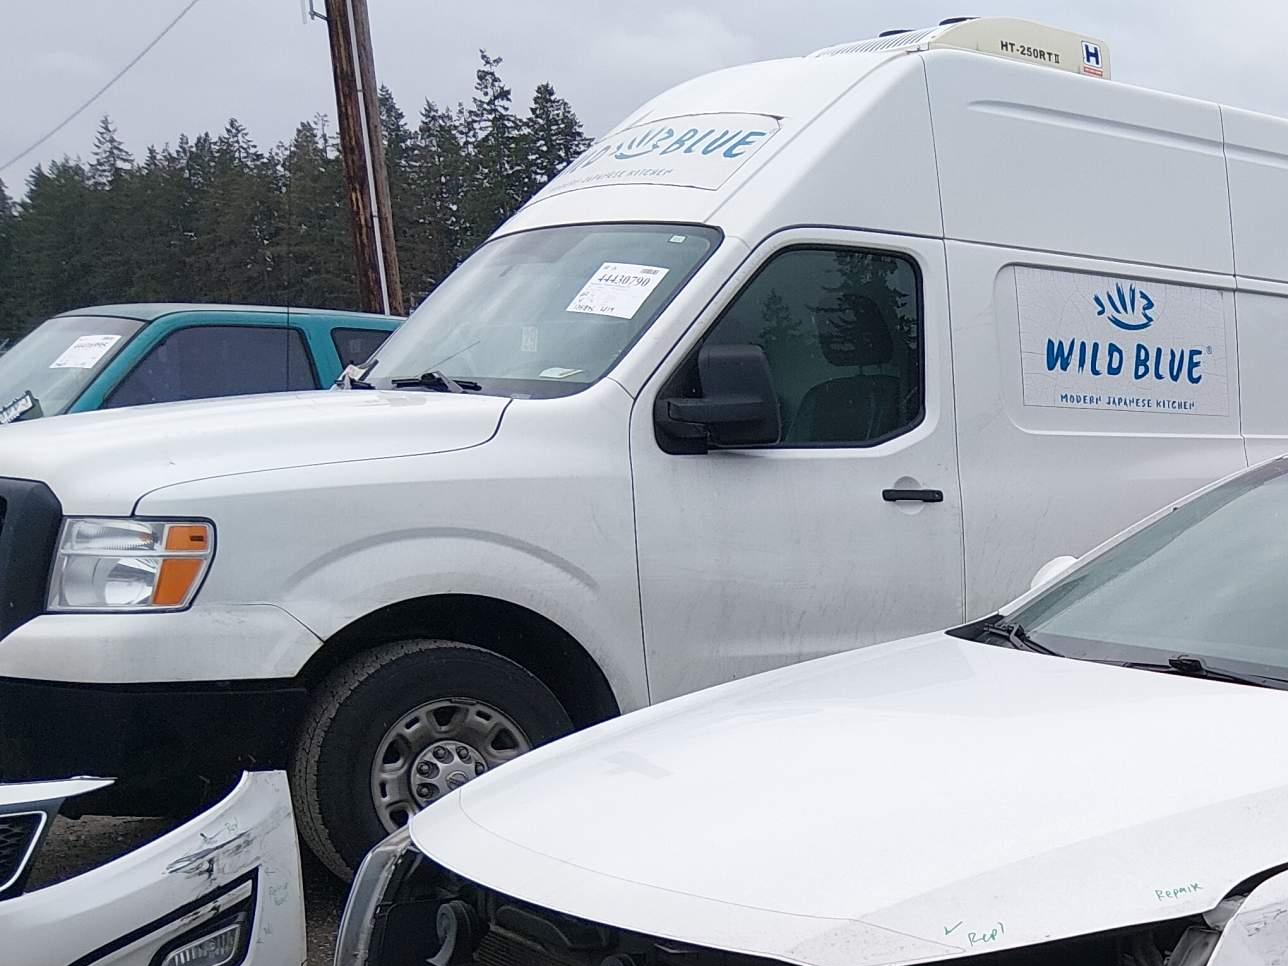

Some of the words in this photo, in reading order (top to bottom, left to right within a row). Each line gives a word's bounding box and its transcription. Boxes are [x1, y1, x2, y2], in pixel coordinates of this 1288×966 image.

[659, 128, 767, 159] BLUE
[597, 273, 652, 288] 44430790
[1046, 337, 1124, 376] WILD
[1133, 343, 1203, 384] BLUE
[1060, 393, 1102, 404] MODERN
[1106, 396, 1153, 409] JAPANESE
[1155, 398, 1196, 410] KITCHEN
